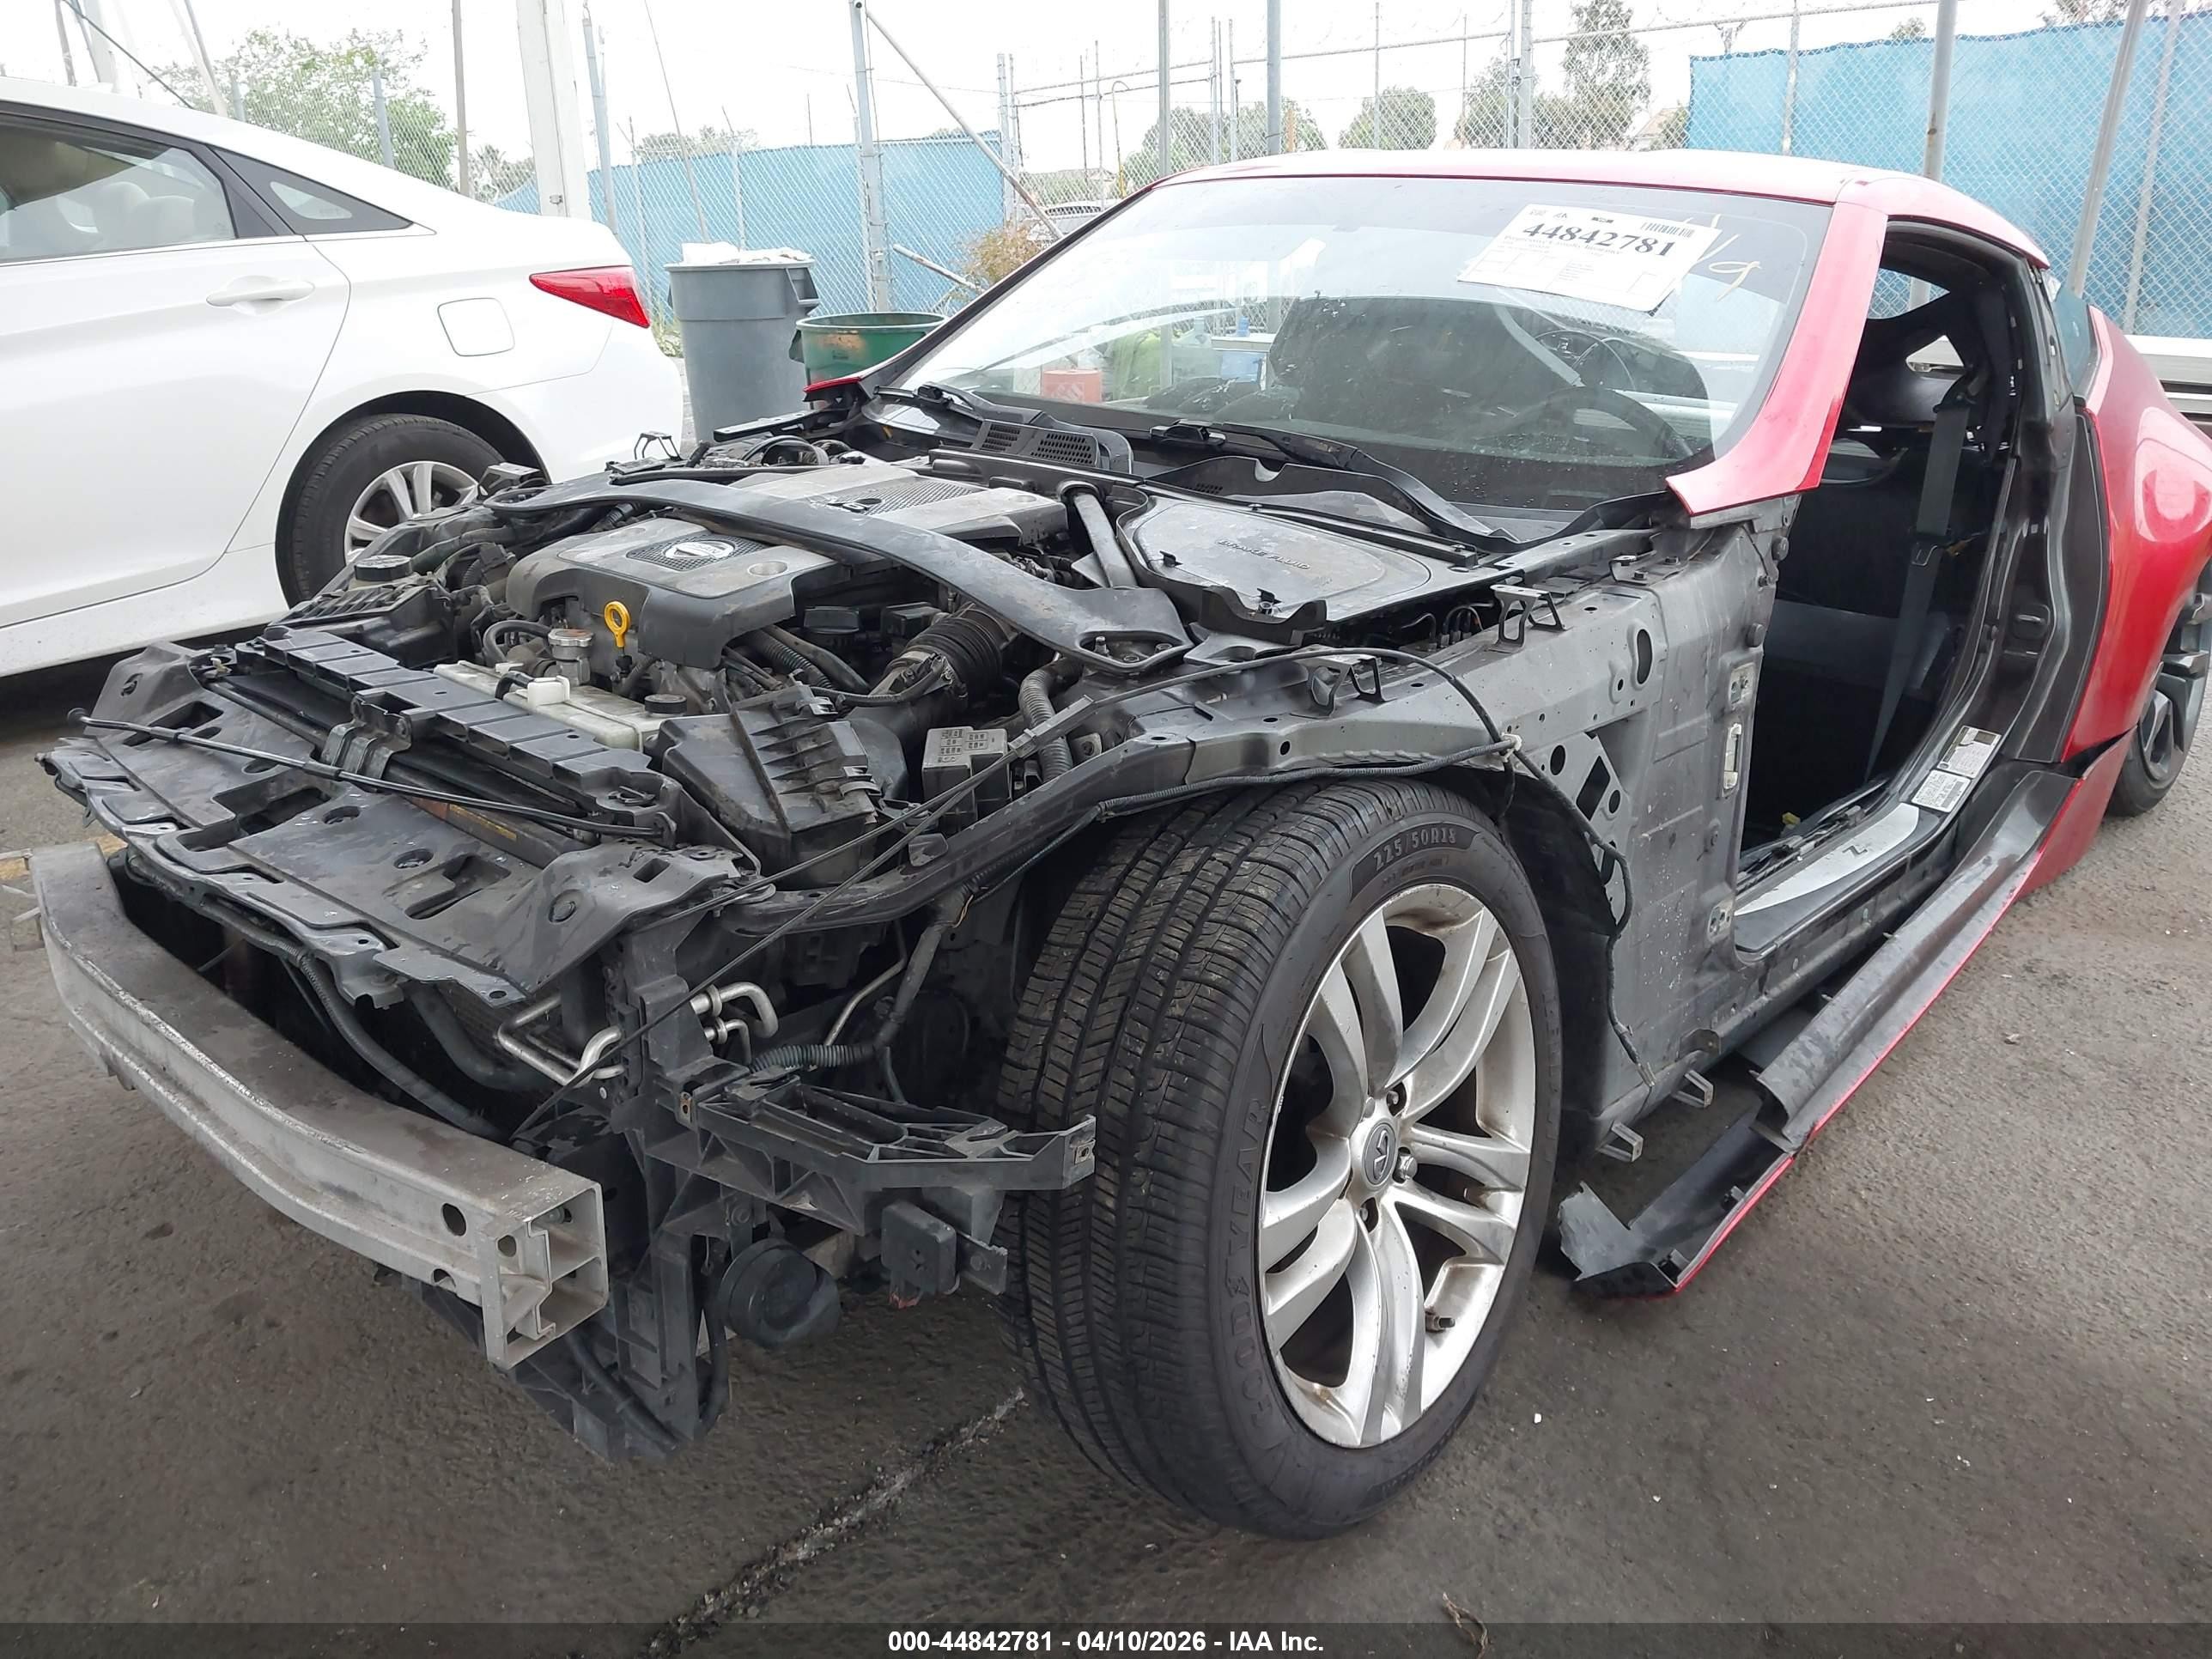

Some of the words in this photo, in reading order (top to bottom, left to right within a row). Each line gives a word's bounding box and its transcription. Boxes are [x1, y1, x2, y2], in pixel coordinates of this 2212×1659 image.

[1522, 222, 1675, 256] 44842781
[1216, 539, 1267, 557] BRAKE
[1267, 554, 1311, 570] FLUID
